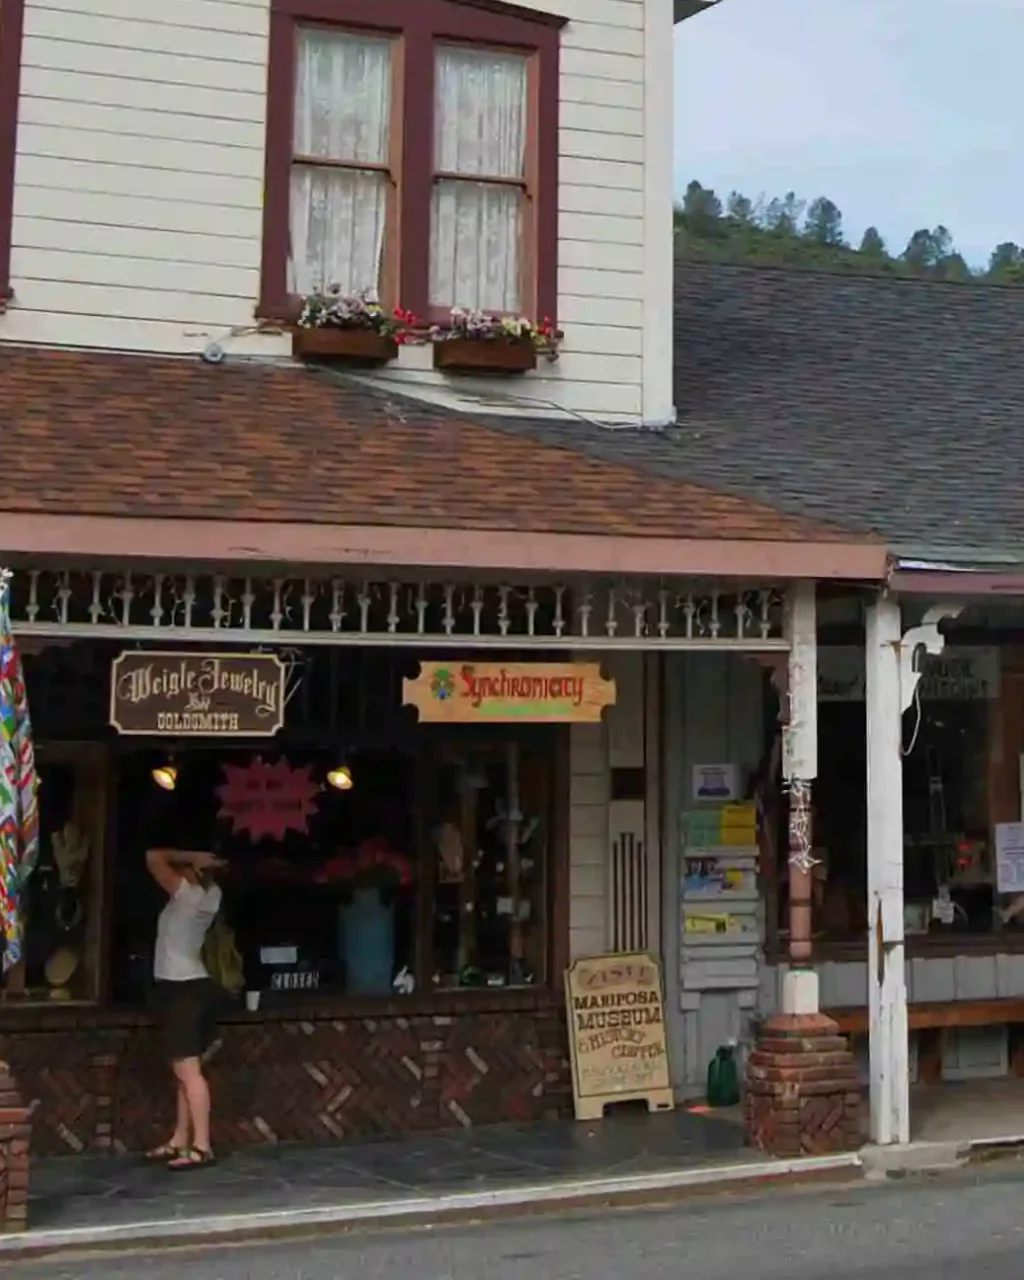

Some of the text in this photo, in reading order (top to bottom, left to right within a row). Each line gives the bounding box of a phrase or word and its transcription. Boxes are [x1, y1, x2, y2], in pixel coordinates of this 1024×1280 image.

[117, 658, 279, 718] Weigle Jewelry
[157, 712, 240, 731] GOLDSMITH
[574, 990, 659, 1010] MARIPOSA
[578, 1007, 662, 1031] MUSEUM
